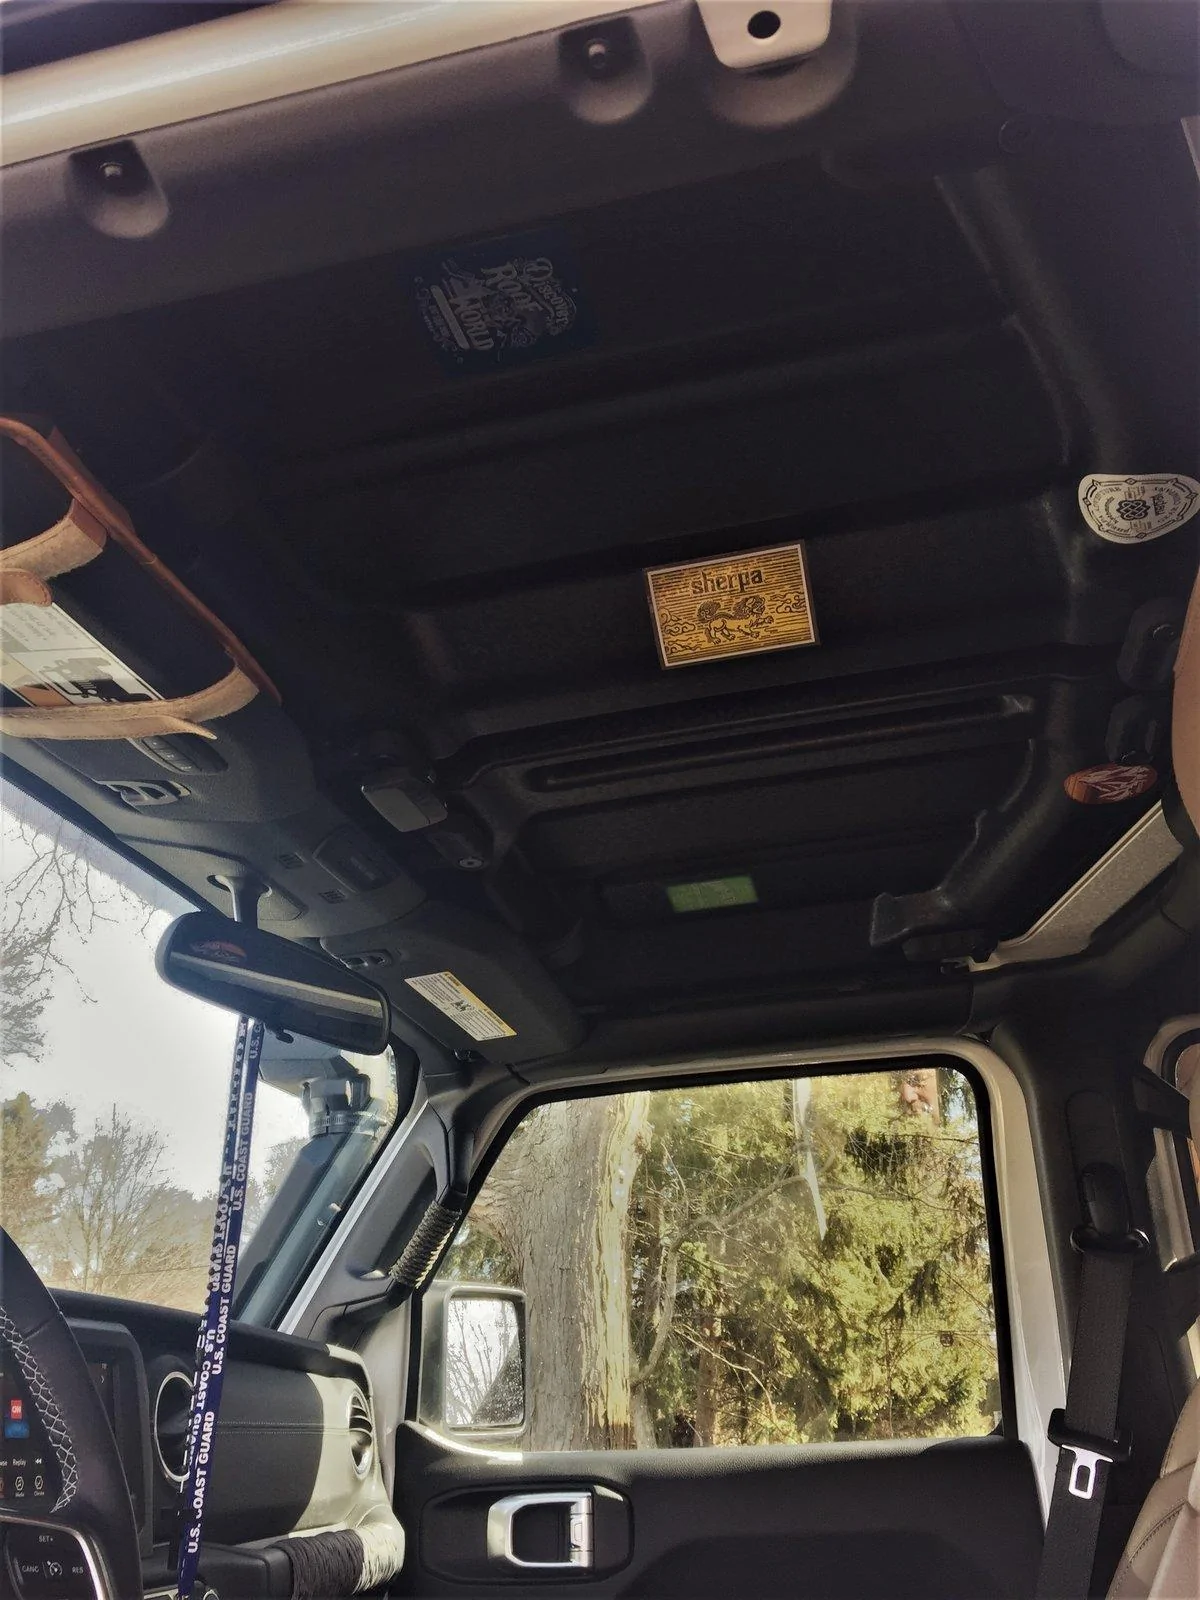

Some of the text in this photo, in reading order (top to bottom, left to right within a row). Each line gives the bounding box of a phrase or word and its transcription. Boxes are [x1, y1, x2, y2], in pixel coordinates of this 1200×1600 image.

[691, 569, 764, 595] sherpa
[241, 1092, 254, 1135] GUARD
[235, 1139, 249, 1182] COAST
[211, 1245, 236, 1375] U.S. COAST GUARD
[196, 1360, 211, 1410] COAST
[187, 1523, 202, 1554] U.S.
[198, 1411, 215, 1465] GUARD
